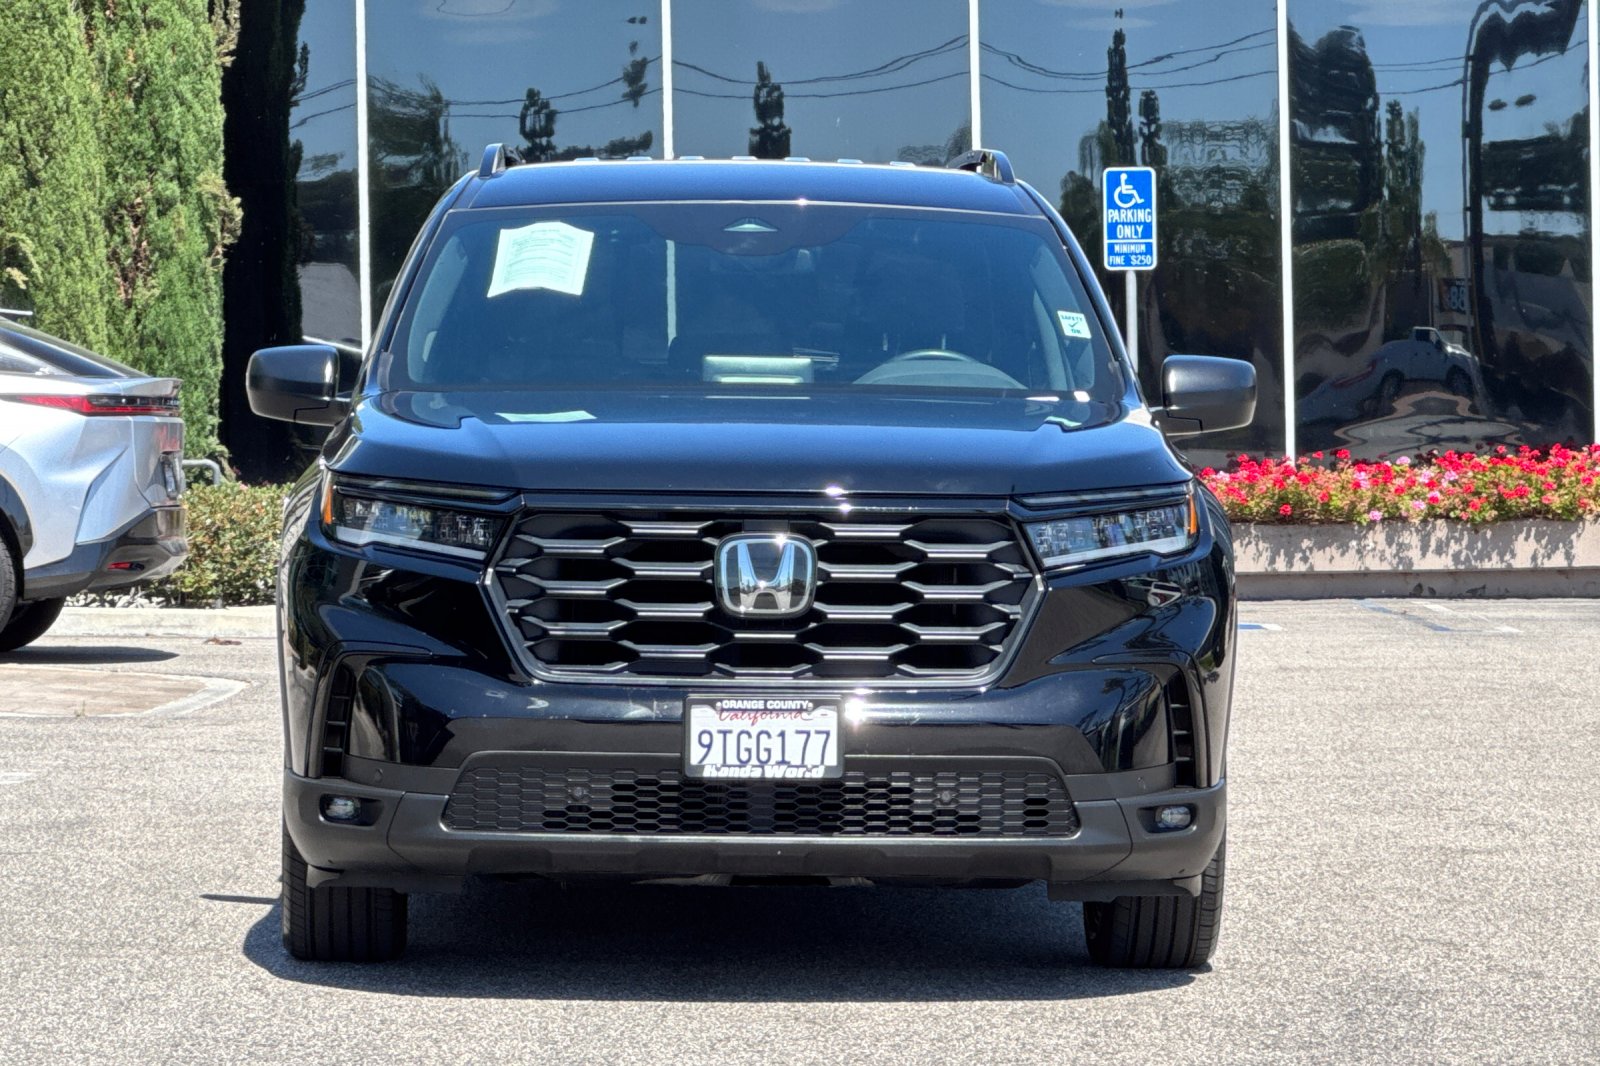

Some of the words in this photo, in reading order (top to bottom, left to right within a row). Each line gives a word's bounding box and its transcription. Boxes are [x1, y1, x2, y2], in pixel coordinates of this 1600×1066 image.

[1107, 208, 1152, 223] PARKING
[1116, 224, 1144, 239] ONLY
[1113, 243, 1146, 254] MINIMUM
[1109, 255, 1125, 265] FINE
[1129, 254, 1152, 266] $250
[722, 700, 765, 709] ORANGE
[766, 700, 809, 709] COUNTY
[718, 709, 813, 727] California
[697, 729, 831, 765] 9TGG177
[702, 764, 763, 778] Honda
